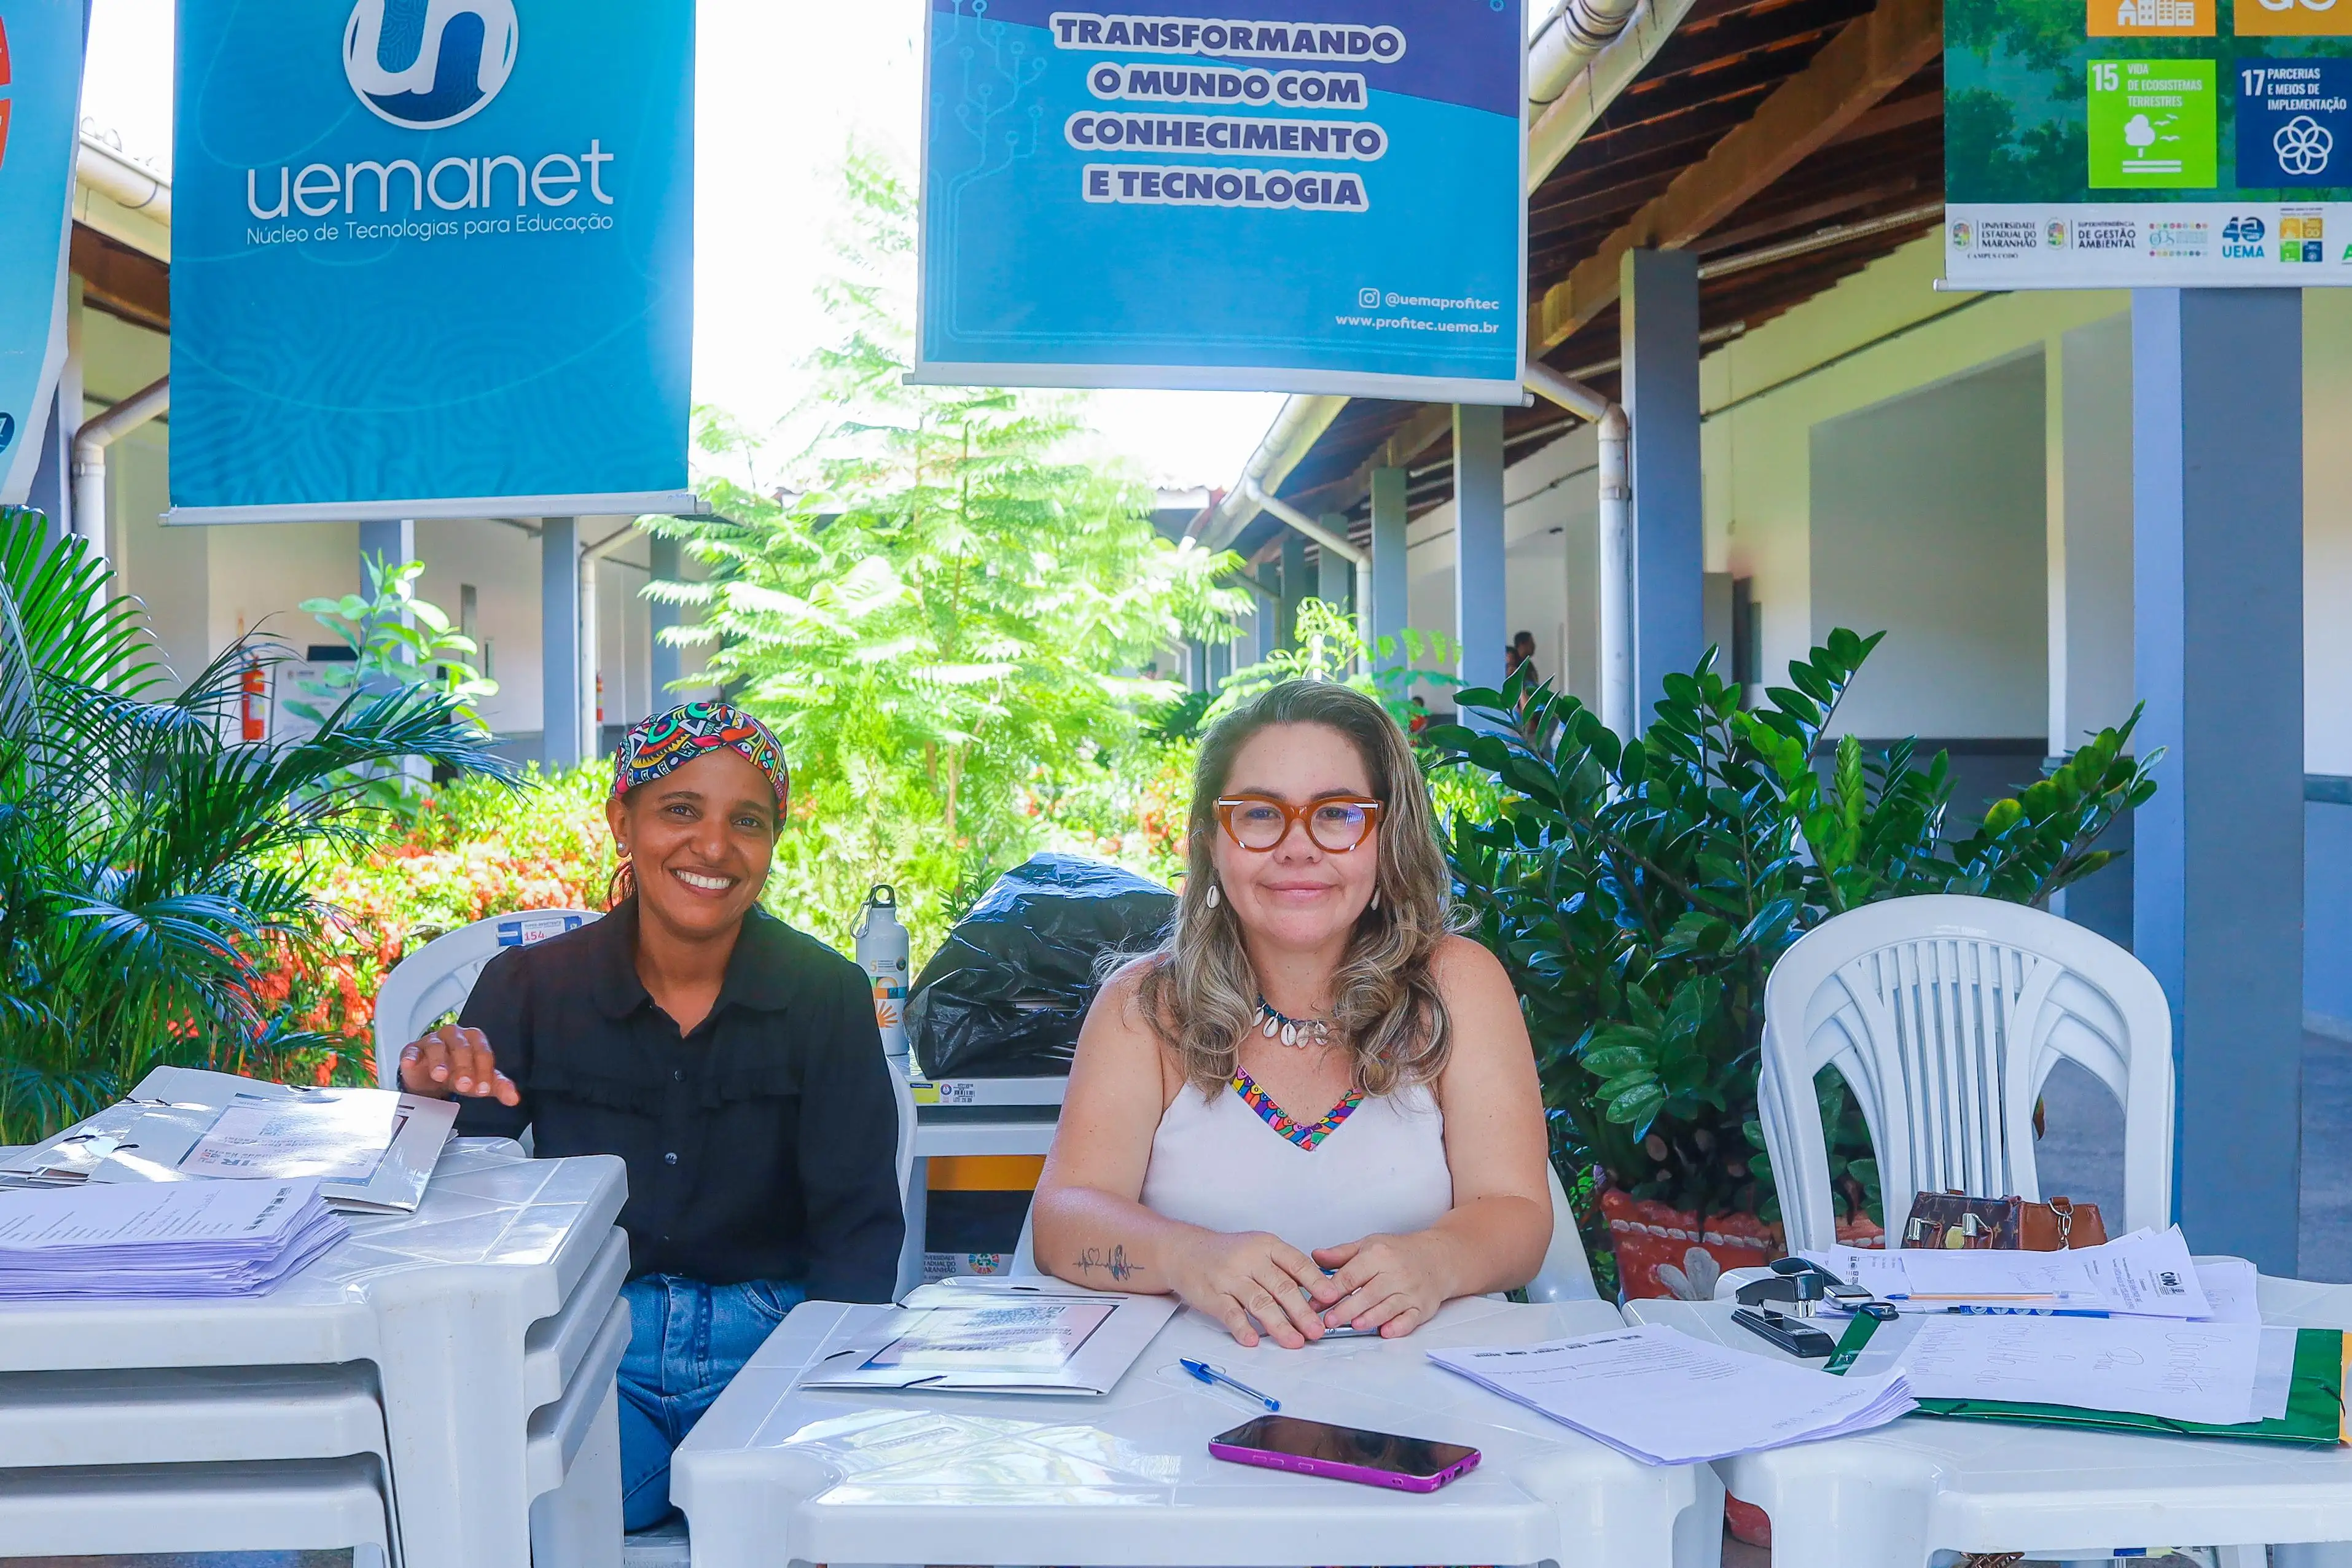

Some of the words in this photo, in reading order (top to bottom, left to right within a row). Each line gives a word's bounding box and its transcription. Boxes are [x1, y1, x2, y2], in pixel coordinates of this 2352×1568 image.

[1056, 18, 1399, 57] TRANSFORMANDO
[1093, 68, 1121, 94] O
[1128, 70, 1270, 100] MUNDO
[1276, 76, 1361, 103] COM
[2092, 63, 2119, 91] 15
[2127, 63, 2149, 75] VIDA
[2128, 80, 2139, 90] DE
[2241, 69, 2265, 96] 17
[2267, 68, 2321, 80] PARCERIAS
[2267, 84, 2273, 95] E
[2275, 84, 2306, 95] MEIOS
[2308, 83, 2320, 95] DE
[2127, 96, 2182, 107] TERRESTRES
[2267, 97, 2347, 114] IMPLEMENTAÇÃO
[1071, 117, 1381, 155] CONHECIMENTO
[247, 139, 614, 220] uemanet
[1090, 171, 1109, 197] E
[1118, 171, 1362, 206] TECNOLOGIA
[247, 223, 308, 244] Núcleo
[314, 221, 338, 241] de
[345, 217, 459, 241] Tecnologias
[464, 217, 512, 239] para
[516, 213, 614, 233] Educação
[2024, 230, 2036, 239] DO
[2078, 230, 2091, 239] DE
[2095, 228, 2136, 239] GESTÃO
[1982, 238, 2036, 248] MARANHÃO
[2079, 239, 2136, 249] AMBIENTAL
[2222, 245, 2265, 259] UEMA
[1385, 292, 1499, 311] @uemaprofitec
[1335, 313, 1499, 334] www.profitec.uema.br
